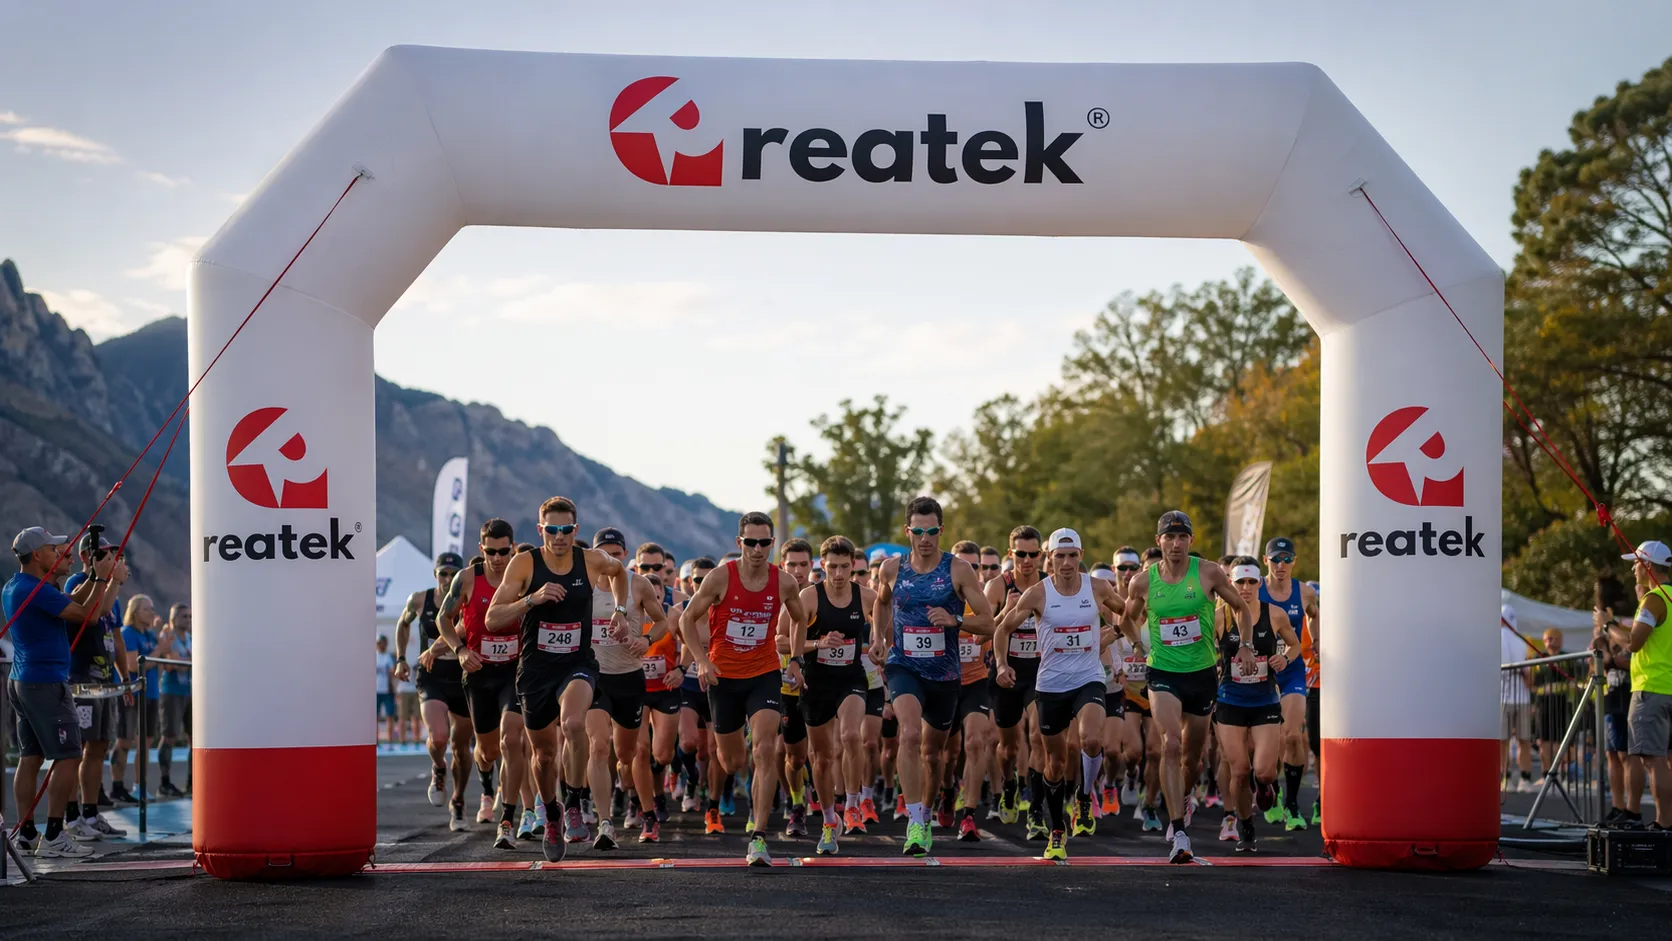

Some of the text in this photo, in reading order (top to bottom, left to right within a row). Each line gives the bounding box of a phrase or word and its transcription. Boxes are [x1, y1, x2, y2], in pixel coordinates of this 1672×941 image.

[1340, 515, 1486, 559] reatek
[740, 625, 755, 637] 12
[1172, 625, 1188, 638] 43
[547, 632, 572, 645] 248
[916, 636, 932, 649] 39
[1066, 634, 1080, 647] 31
[829, 647, 844, 659] 39
